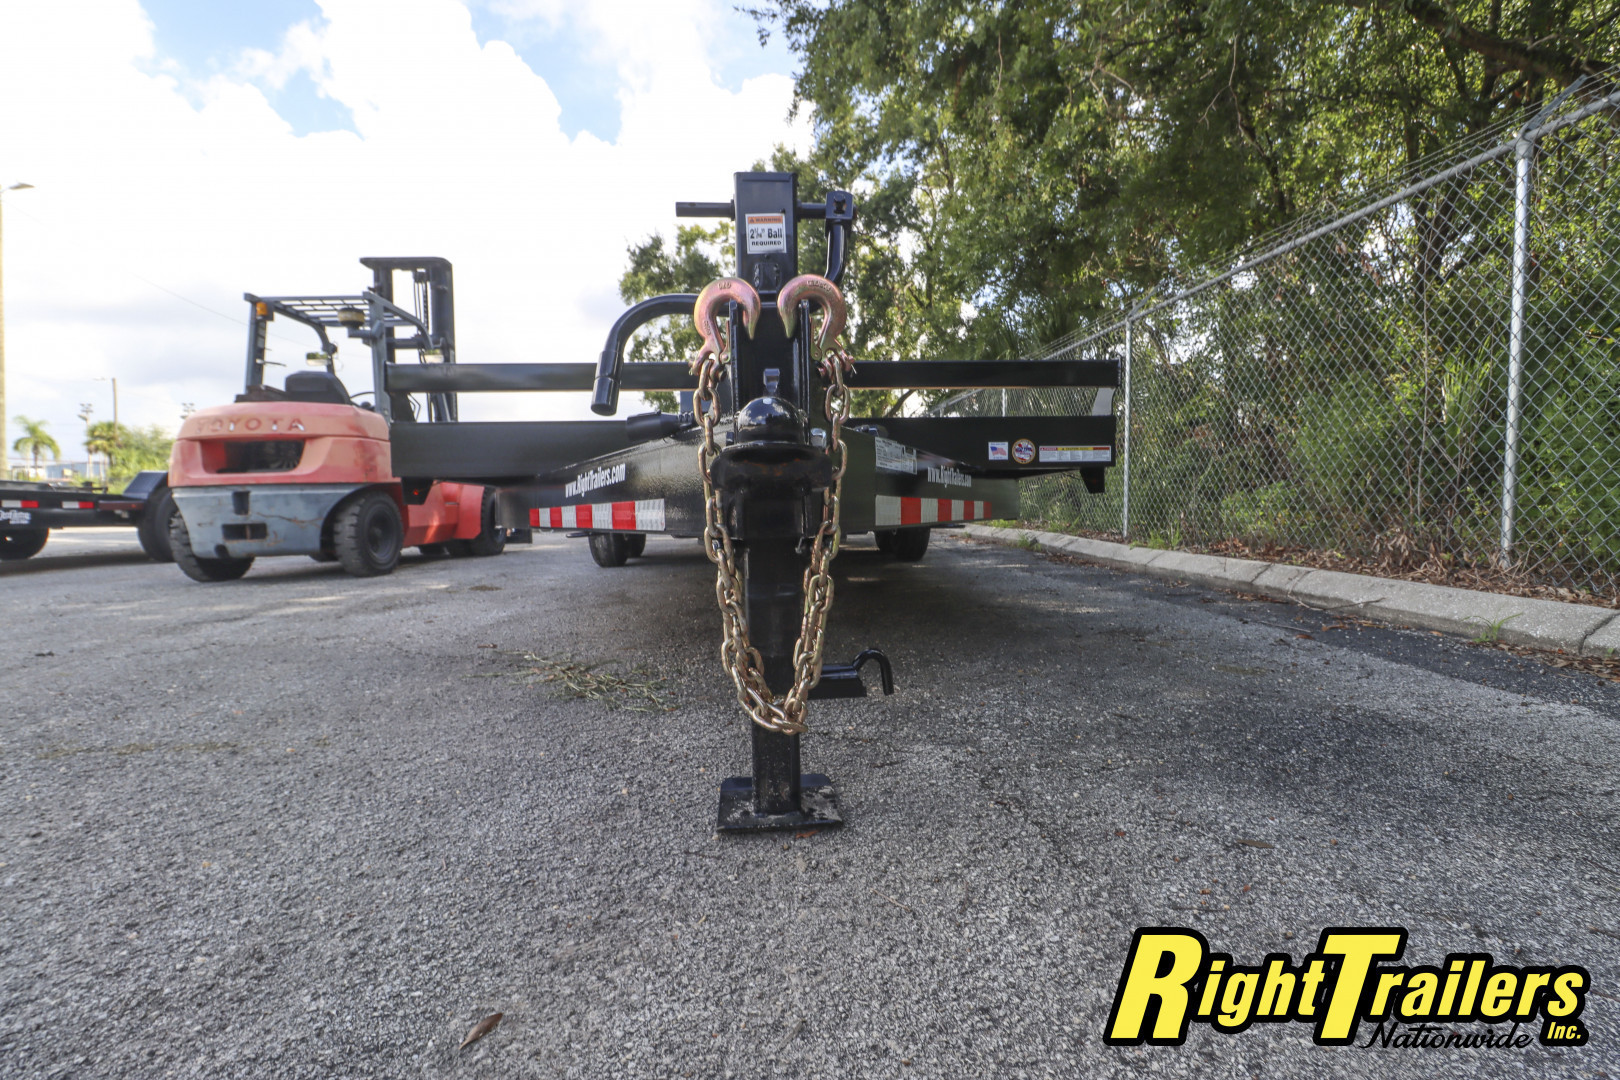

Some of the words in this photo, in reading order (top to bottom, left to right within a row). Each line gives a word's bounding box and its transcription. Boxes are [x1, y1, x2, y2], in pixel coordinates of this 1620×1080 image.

[767, 228, 783, 239] Ball
[195, 417, 305, 434] TOYOTA
[565, 463, 626, 498] www.RightTrailers.com
